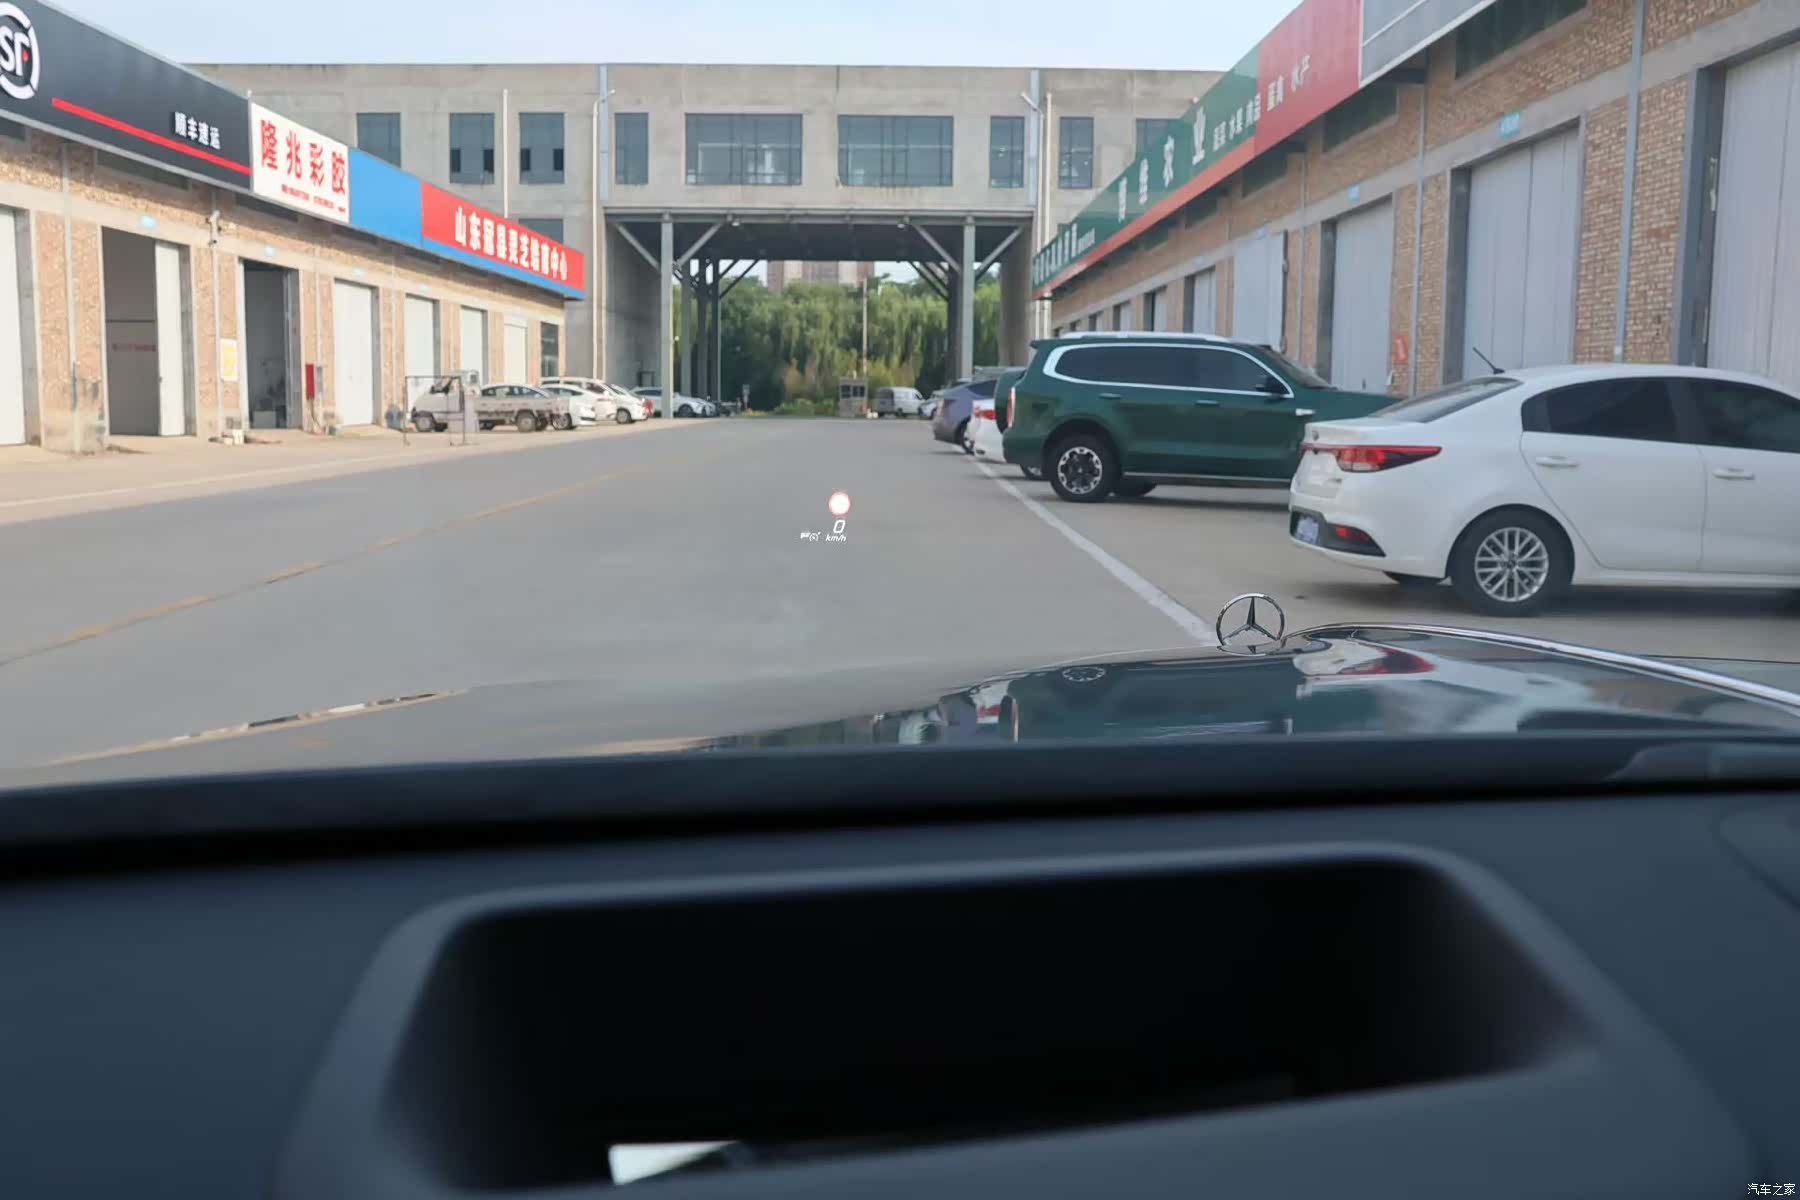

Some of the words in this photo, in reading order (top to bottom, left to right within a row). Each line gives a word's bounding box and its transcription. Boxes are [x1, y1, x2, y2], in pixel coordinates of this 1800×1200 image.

[0, 25, 30, 76] SF
[174, 111, 221, 150] 顺丰速运
[825, 534, 847, 542] km/h
[833, 520, 846, 533] 0
